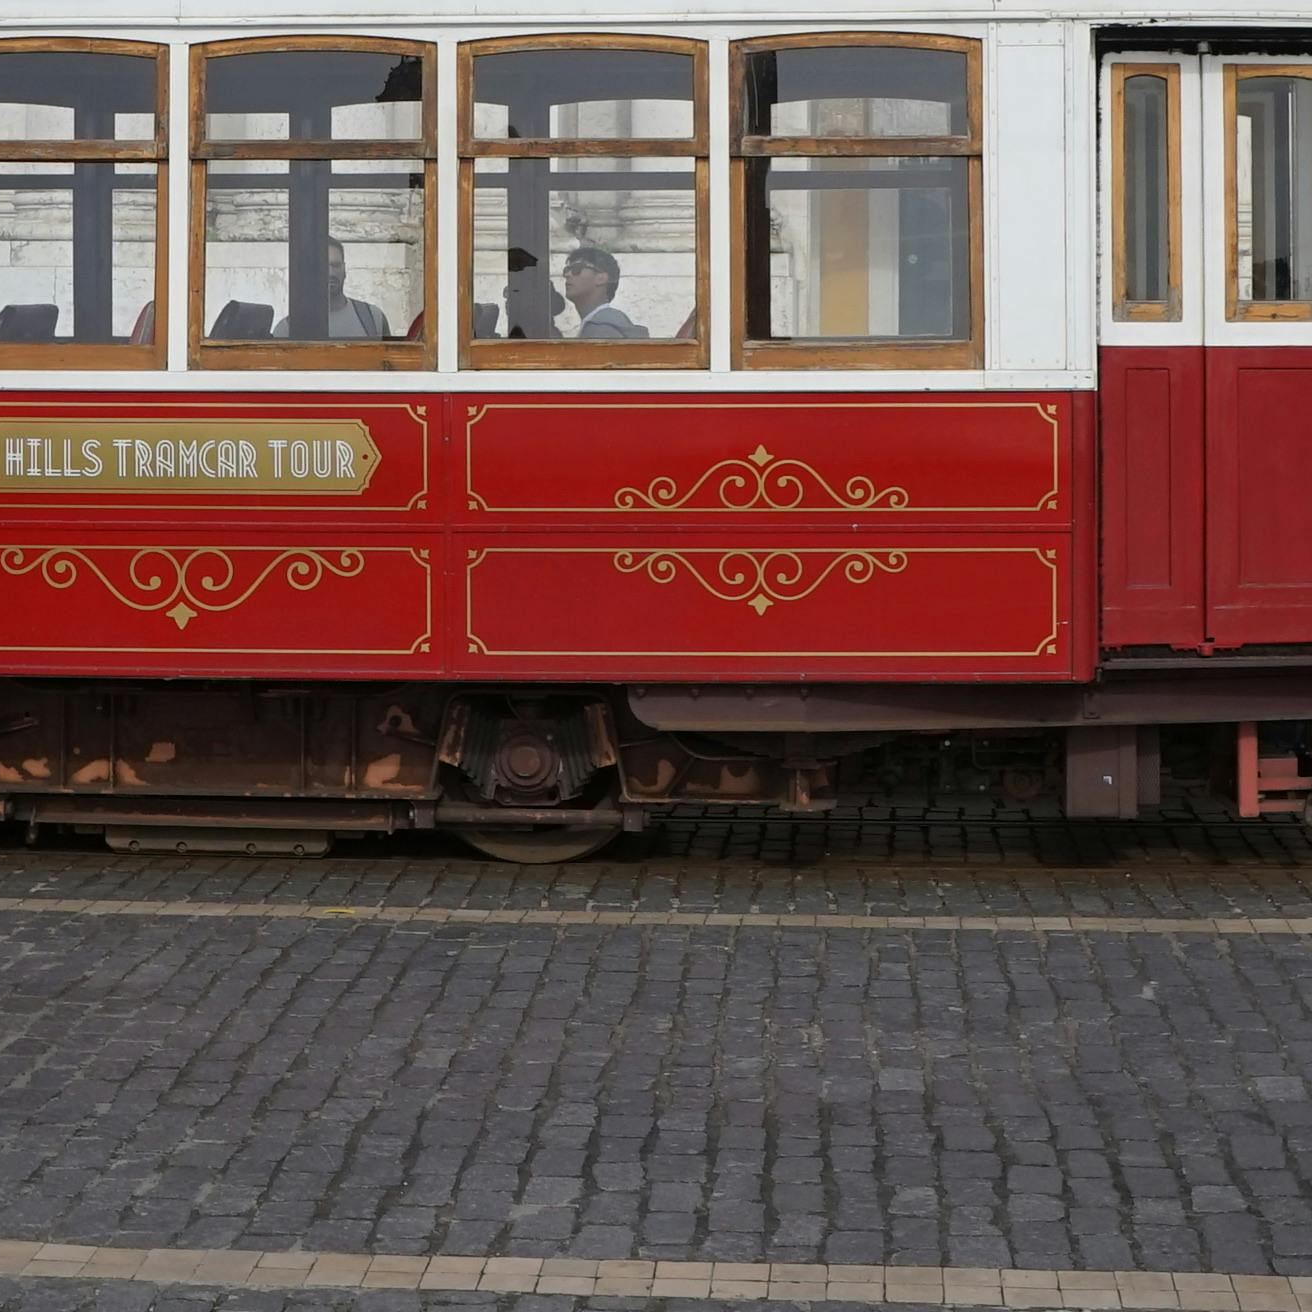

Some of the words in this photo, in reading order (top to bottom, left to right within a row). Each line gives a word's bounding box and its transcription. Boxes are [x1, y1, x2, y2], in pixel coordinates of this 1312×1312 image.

[5, 438, 103, 477] HILLS
[112, 439, 258, 478] TRAMCAR
[268, 439, 356, 479] TOUR
